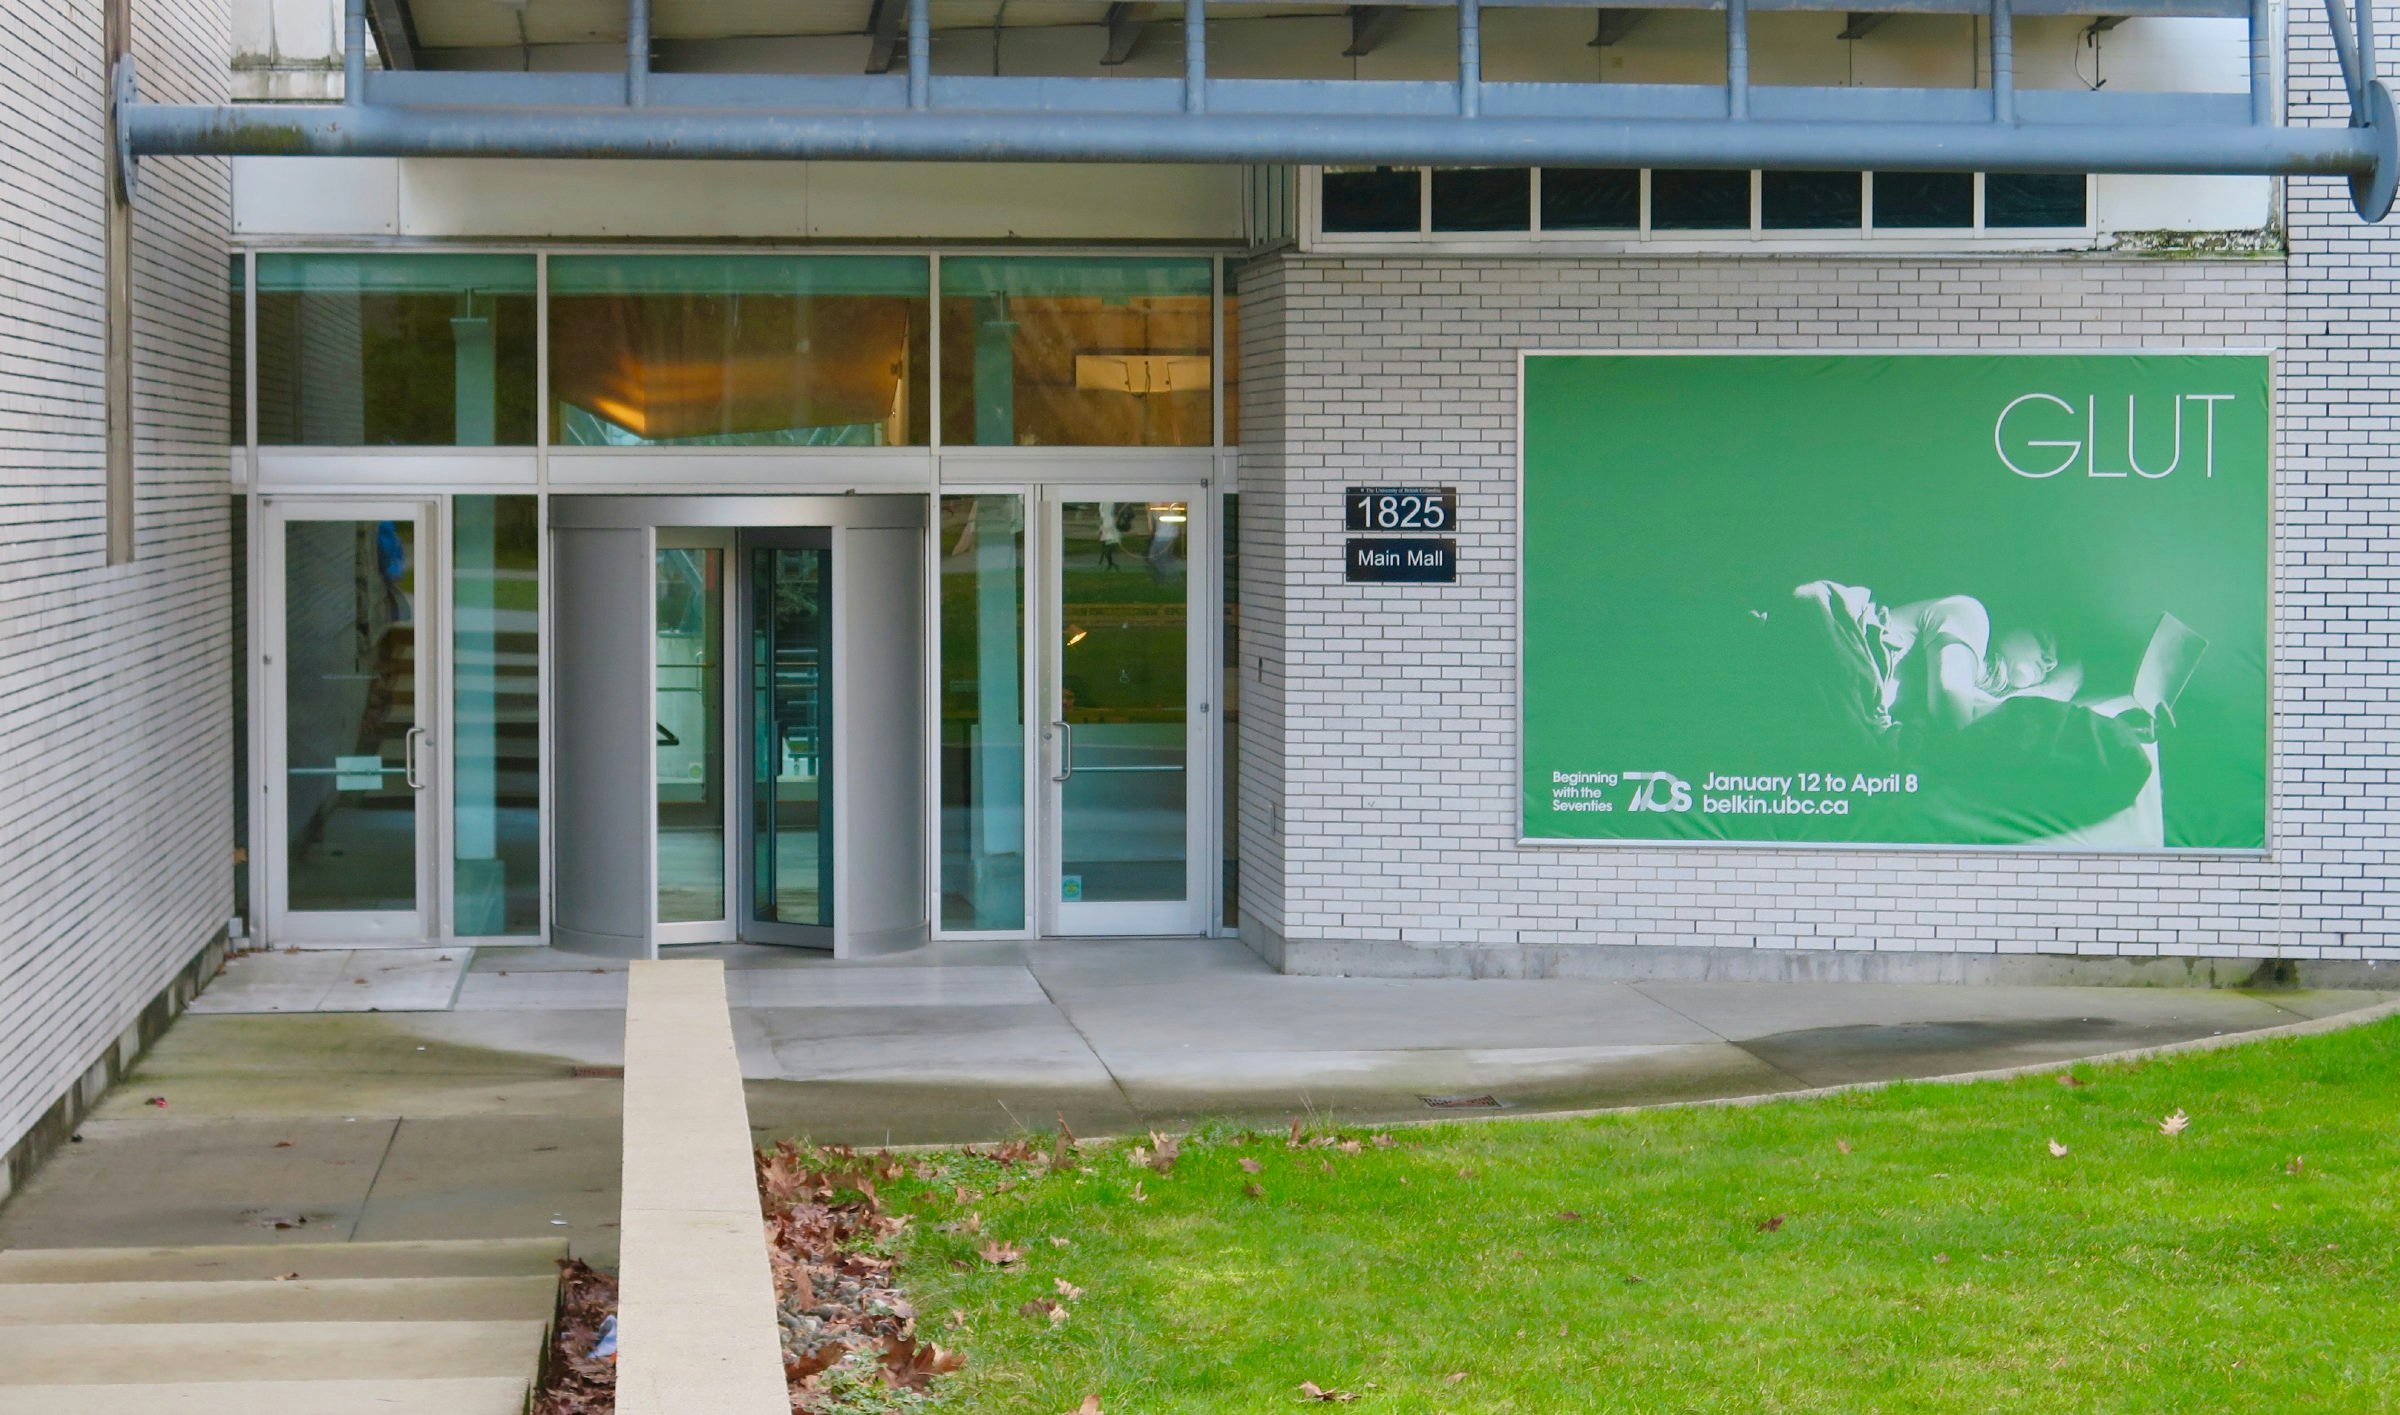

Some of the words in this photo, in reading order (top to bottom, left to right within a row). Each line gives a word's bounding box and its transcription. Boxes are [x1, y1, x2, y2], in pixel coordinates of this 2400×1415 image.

[1994, 393, 2235, 478] GLUT
[1358, 496, 1444, 528] 1825
[1358, 550, 1400, 566] Main
[1407, 550, 1443, 566] Mall
[1552, 771, 1618, 786] Beginning
[1702, 771, 1792, 796] January
[1798, 773, 1820, 792] 12
[1825, 773, 1847, 792] to
[1850, 773, 1900, 796] April
[1904, 774, 1918, 793] 8
[1552, 787, 1579, 798] with
[1580, 787, 1601, 798] the
[1552, 799, 1613, 812] Seventies
[1703, 795, 1849, 814] belkin.ubc.ca
